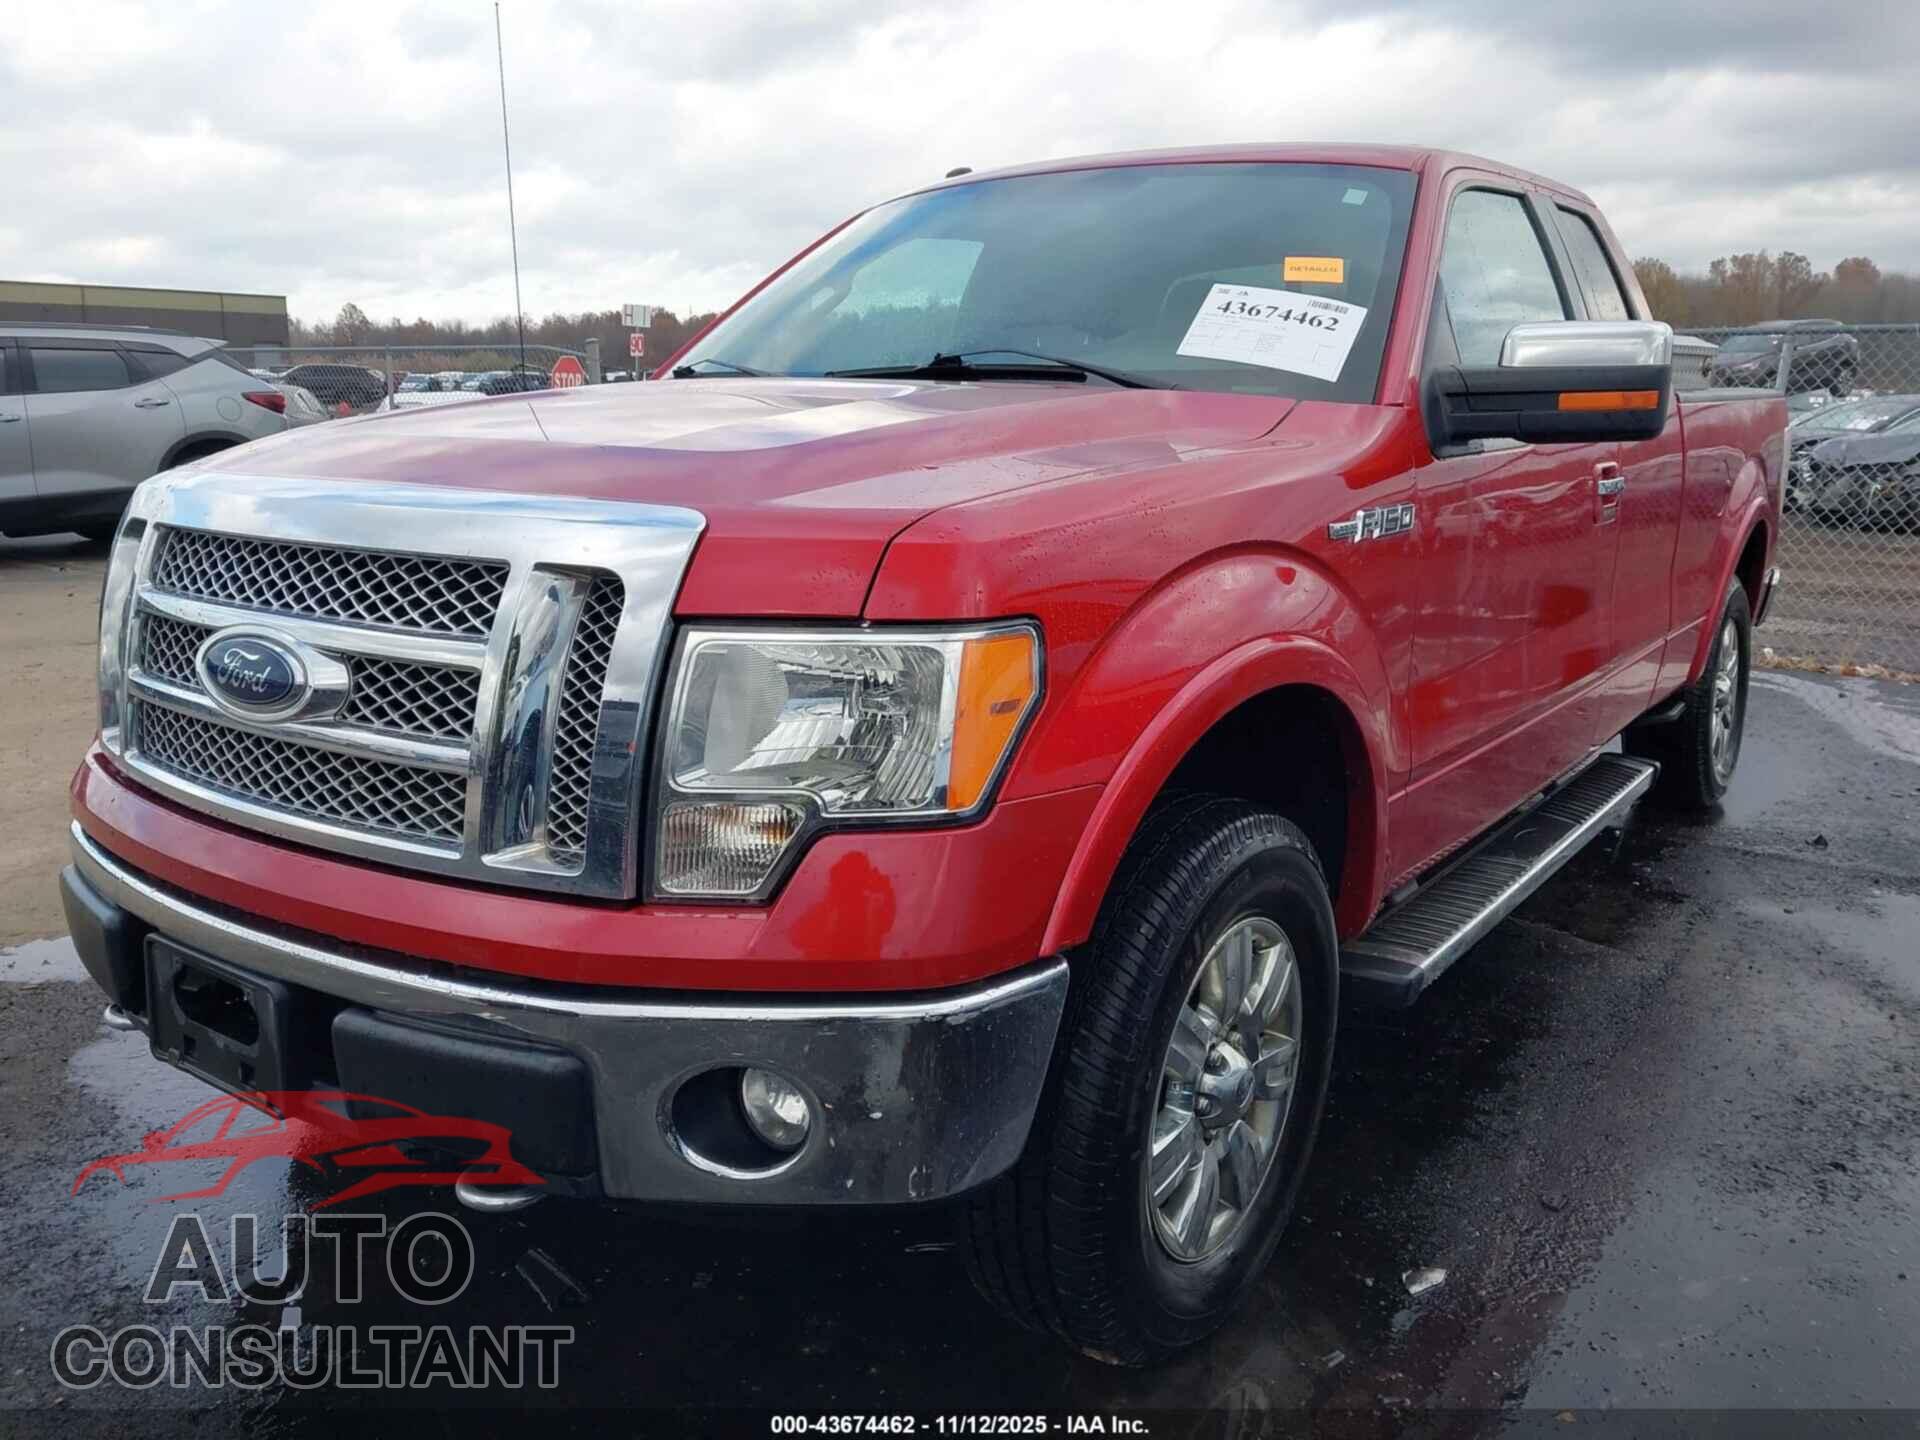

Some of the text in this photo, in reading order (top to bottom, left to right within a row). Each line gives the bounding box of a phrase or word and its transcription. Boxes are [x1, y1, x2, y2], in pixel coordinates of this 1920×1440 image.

[1216, 299, 1340, 332] 43674462
[554, 372, 582, 389] STOP
[216, 647, 272, 693] Ford
